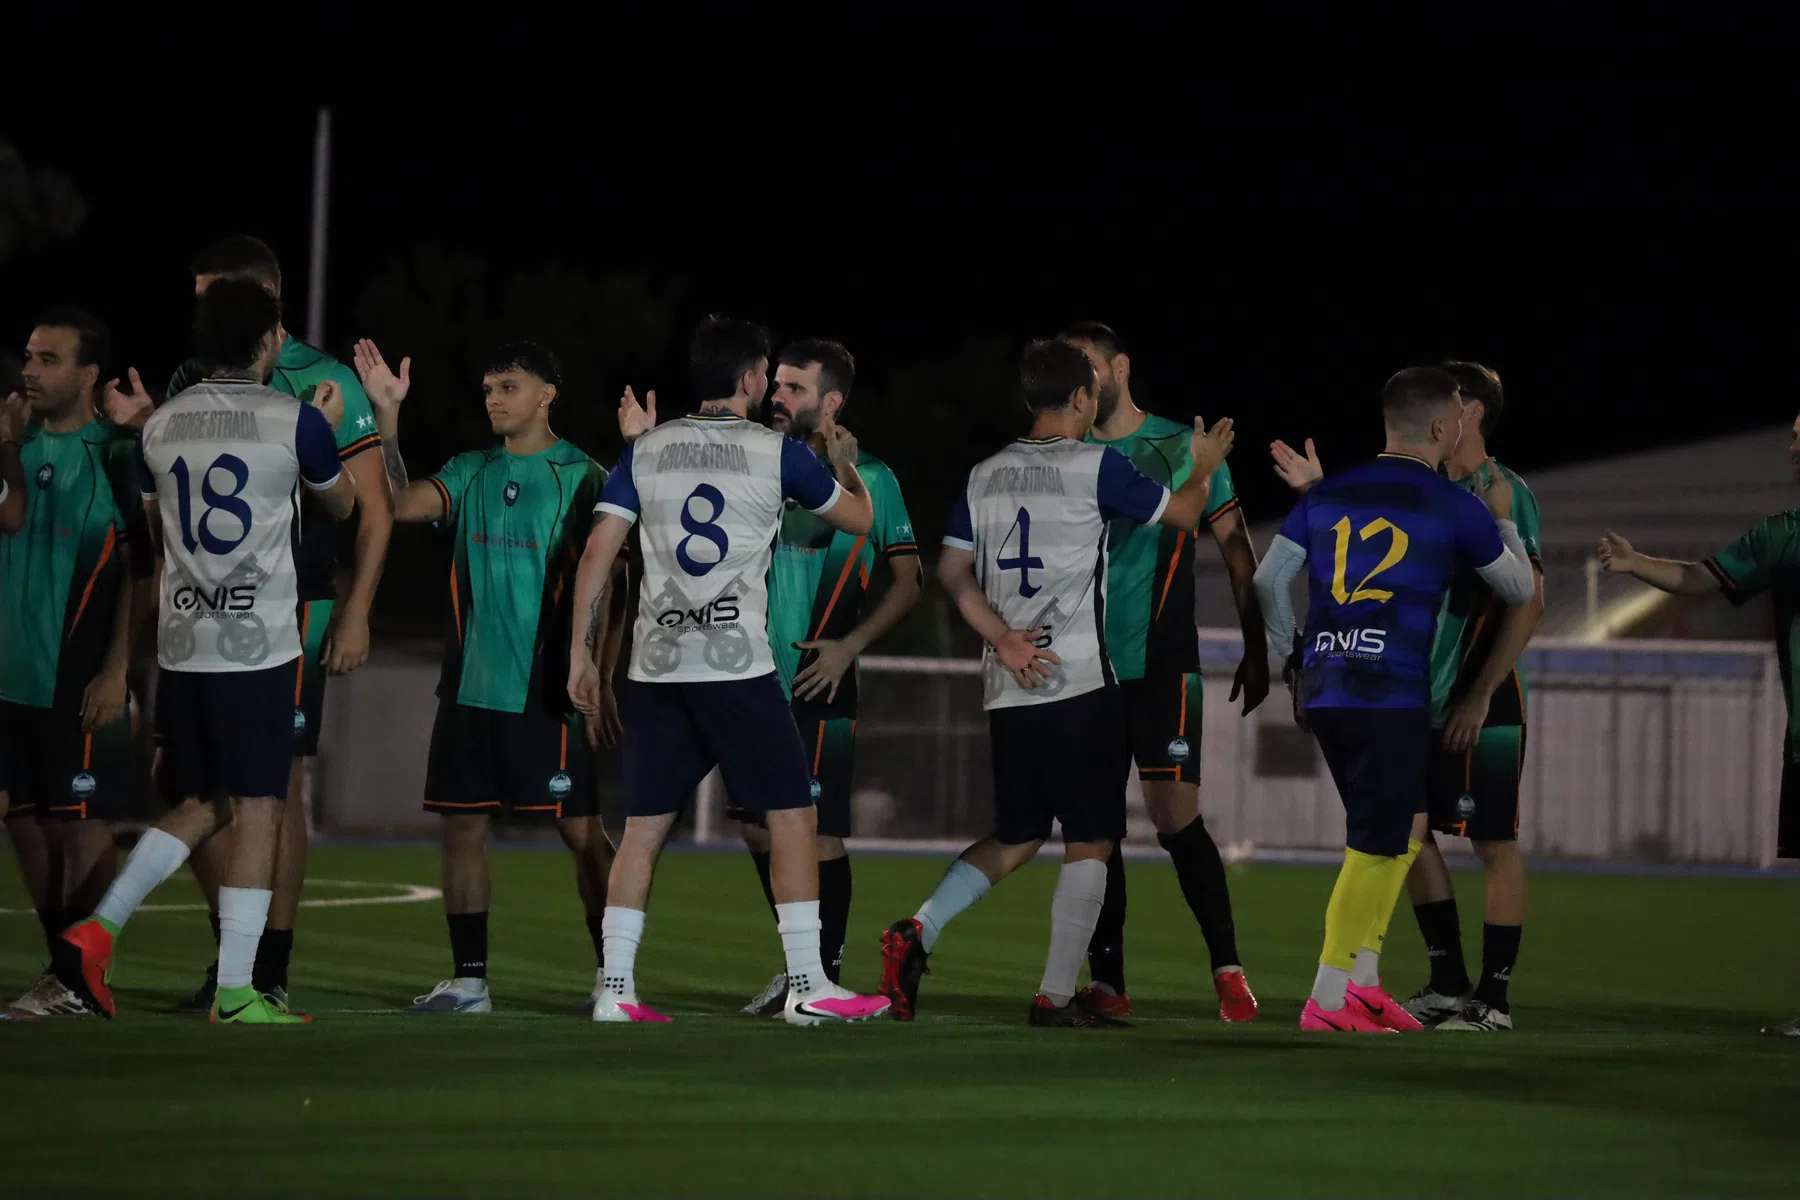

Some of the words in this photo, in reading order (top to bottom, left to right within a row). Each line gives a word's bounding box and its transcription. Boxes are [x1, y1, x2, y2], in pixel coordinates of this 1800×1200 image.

[168, 453, 252, 556] 18
[676, 483, 729, 577] 8
[996, 506, 1044, 599] 4
[1330, 515, 1409, 606] 12
[677, 622, 740, 634] sportswear
[1327, 650, 1383, 661] sportswear
